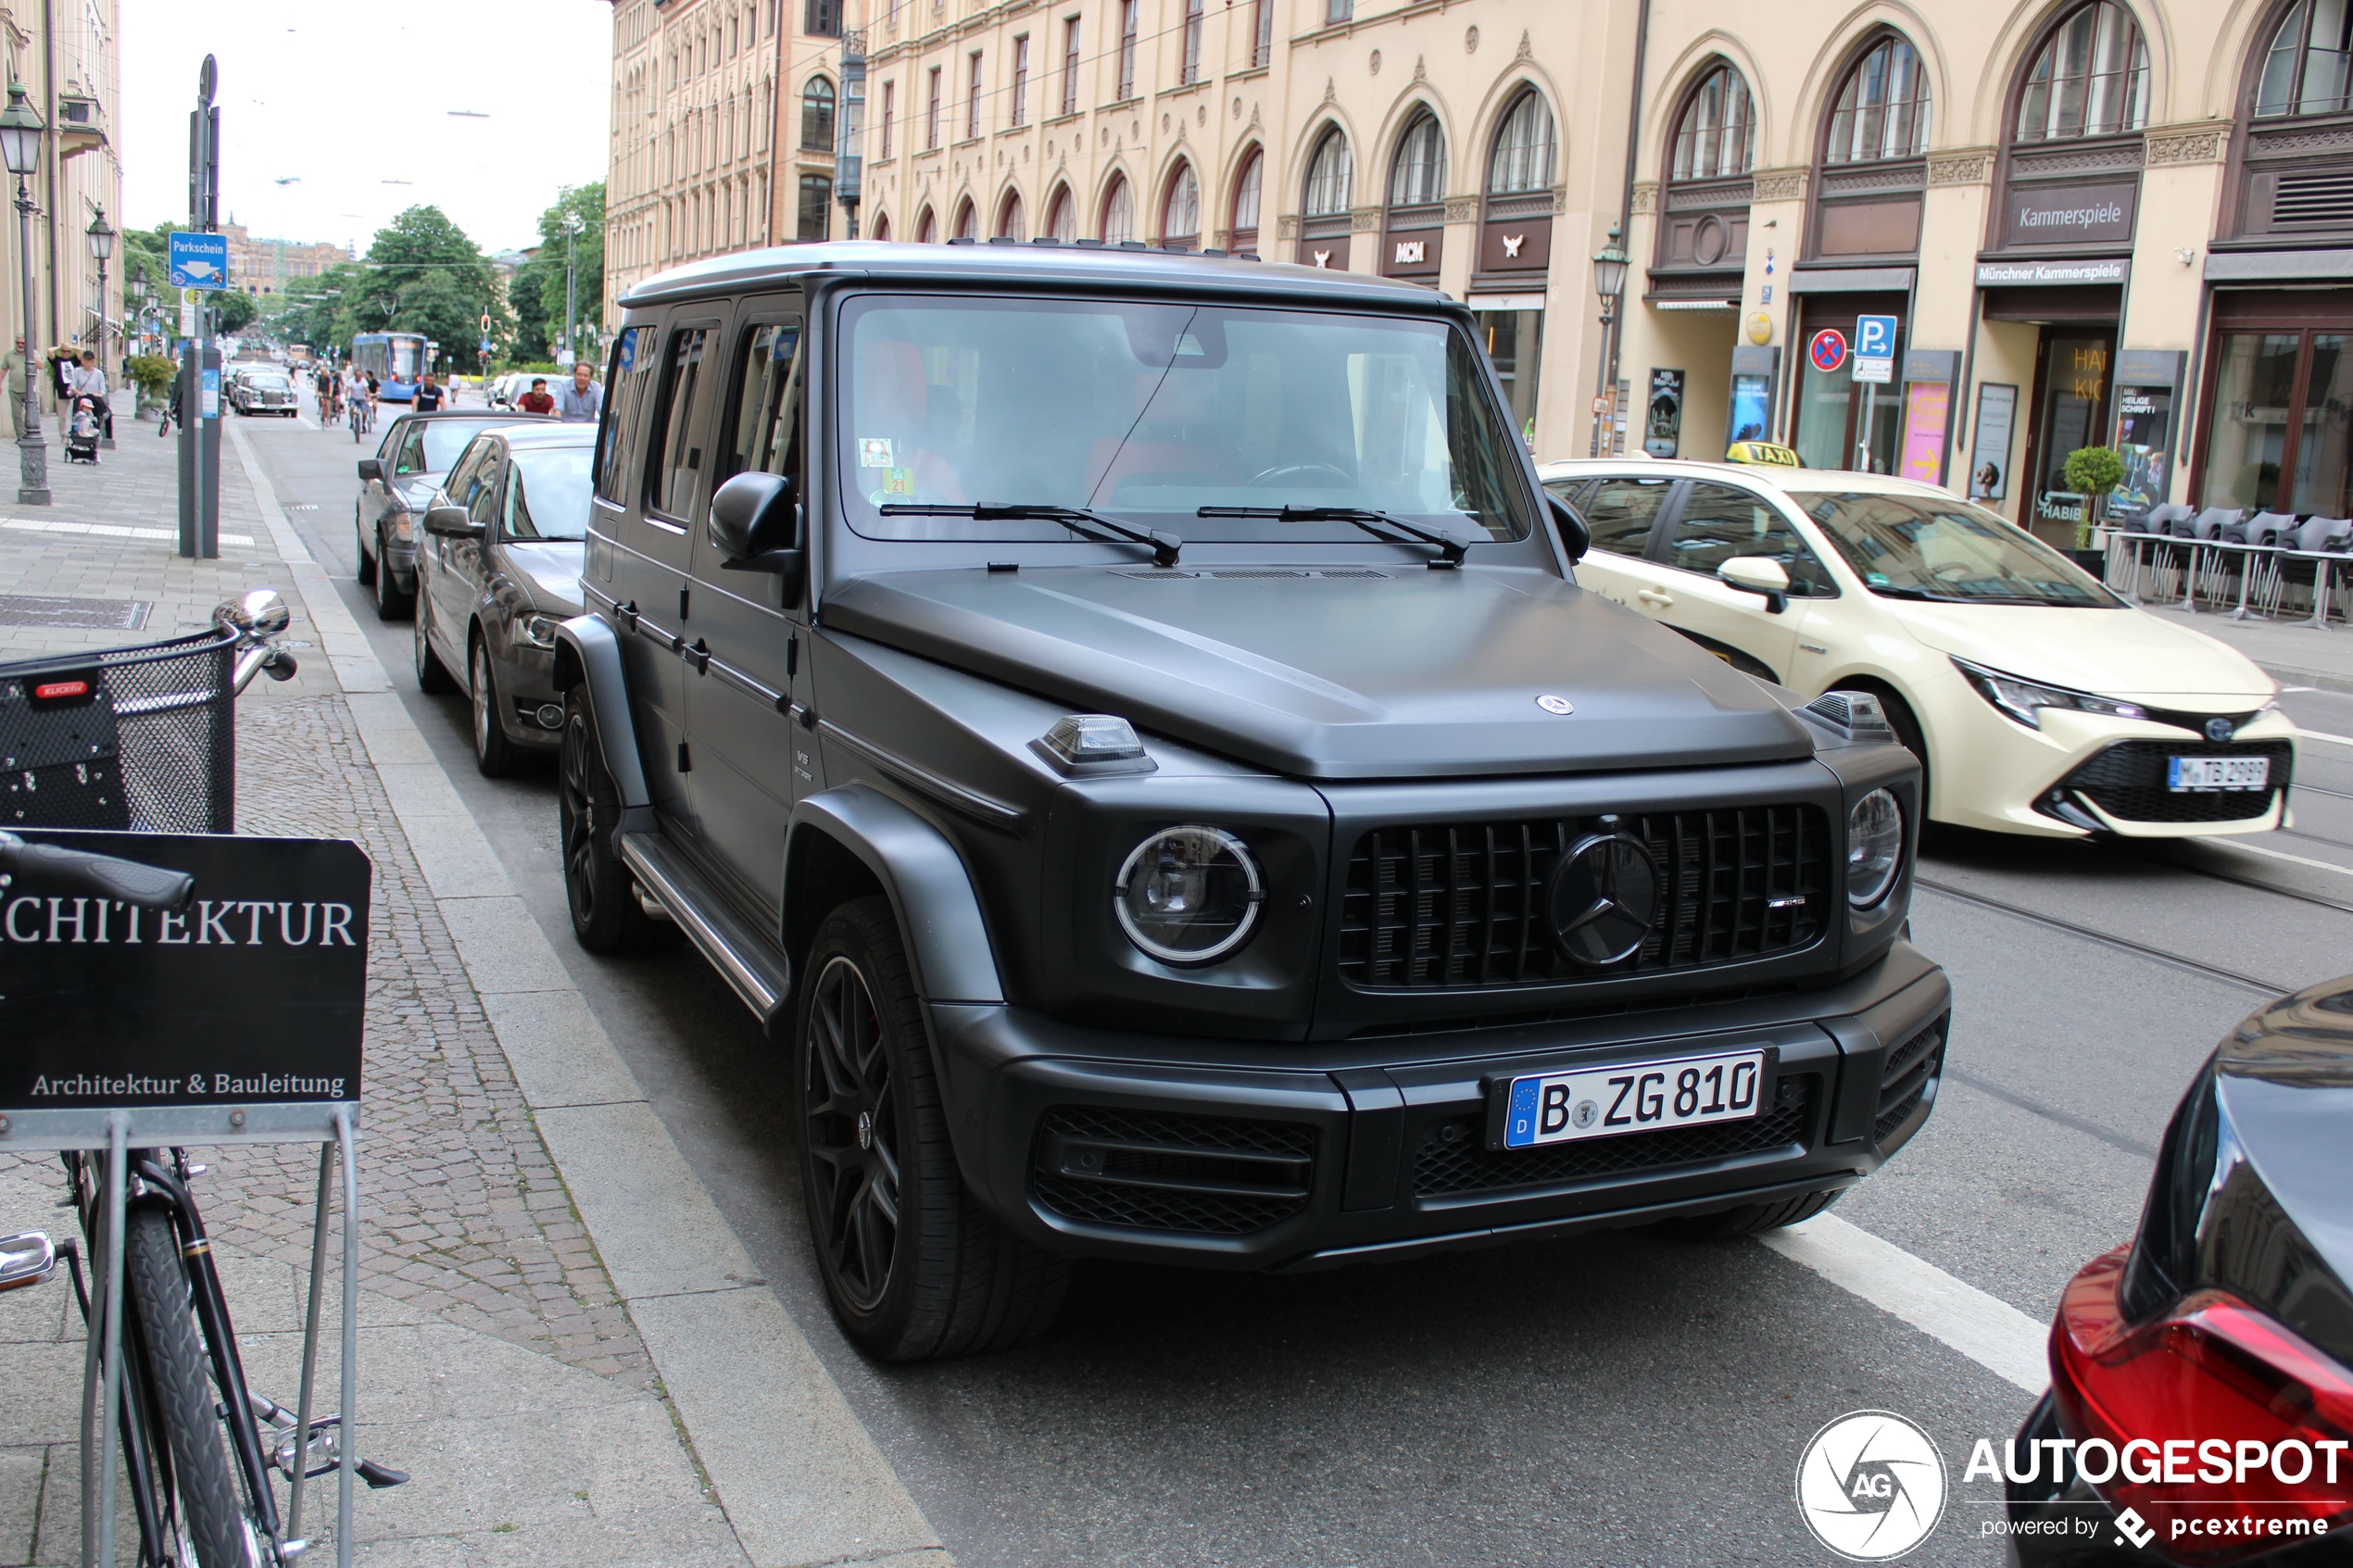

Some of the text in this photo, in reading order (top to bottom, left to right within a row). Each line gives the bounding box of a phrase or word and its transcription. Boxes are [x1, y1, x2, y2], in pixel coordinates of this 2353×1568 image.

[2020, 202, 2121, 229] Kammerspiele
[173, 241, 223, 255] Parkschein
[1395, 242, 1425, 264] MCM
[1979, 264, 2120, 282] Münchner Kammerspiele
[1861, 320, 1884, 353] P
[2074, 348, 2107, 371] HA
[2121, 396, 2150, 406] HEILIGE
[2122, 388, 2137, 396] MK:
[2120, 405, 2151, 414] SCHRIFT
[1752, 445, 1793, 465] TAXI
[892, 480, 905, 492] 21
[2205, 761, 2222, 783] TB
[0, 897, 356, 946] CHITEKTUR
[31, 1073, 345, 1098] Architektur & Bauleitung
[1540, 1084, 1570, 1135] B
[1604, 1072, 1665, 1127] ZG
[1673, 1060, 1756, 1118] 810
[1516, 1119, 1528, 1134] D
